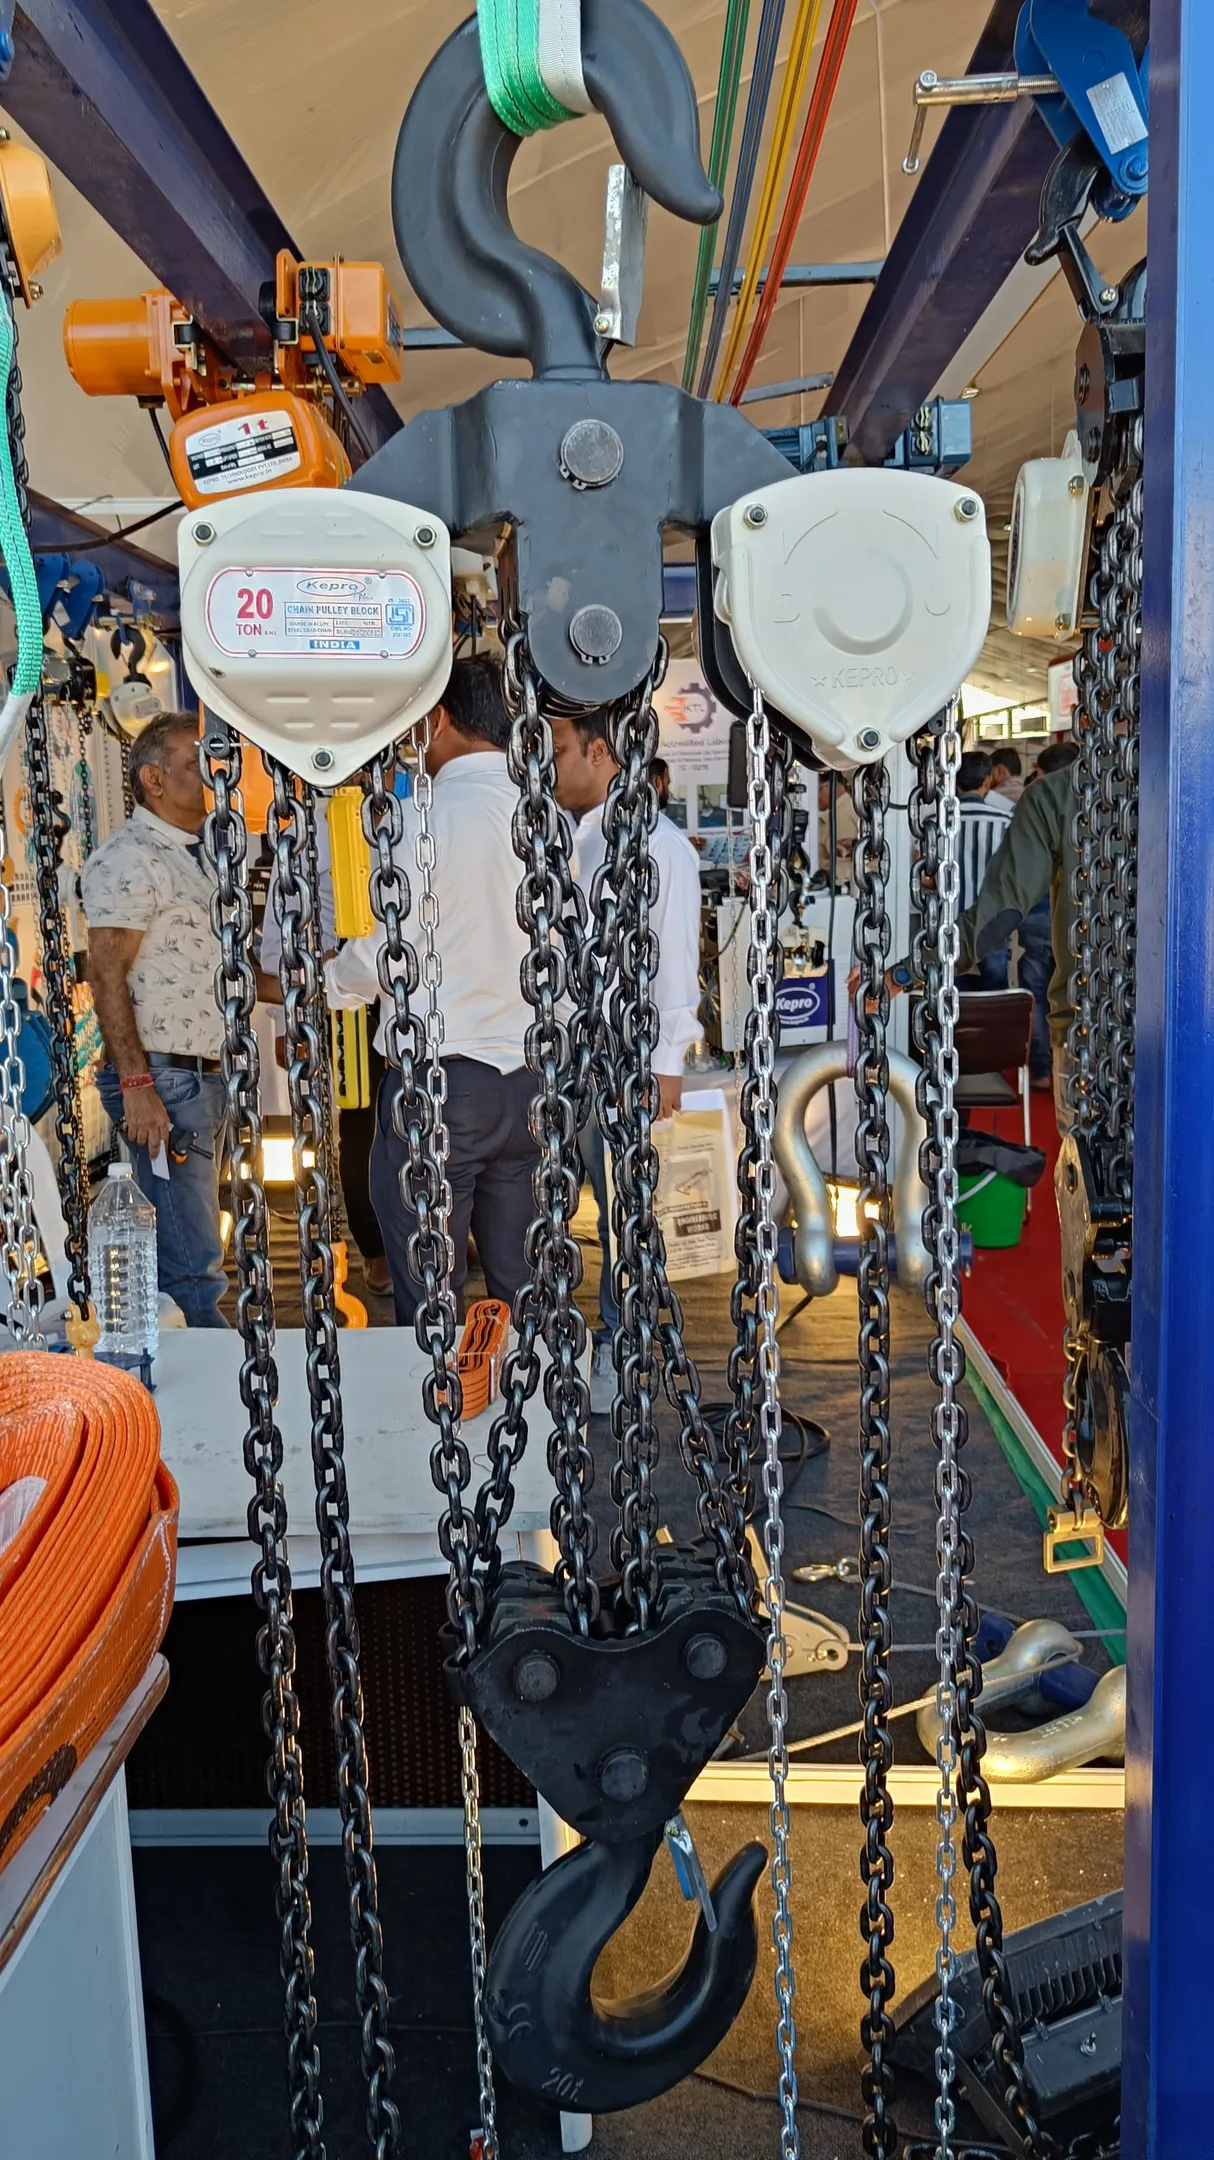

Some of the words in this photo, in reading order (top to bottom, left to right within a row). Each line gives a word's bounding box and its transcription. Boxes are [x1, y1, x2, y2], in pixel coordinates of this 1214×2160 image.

[238, 423, 251, 435] 1
[257, 419, 269, 430] t
[306, 581, 358, 591] Kepro
[237, 588, 273, 619] 20
[287, 605, 314, 614] CHAIN
[316, 606, 348, 615] PULLEY
[350, 607, 379, 616] BLOCK
[235, 623, 262, 636] TON
[313, 641, 356, 650] INDIA
[831, 666, 898, 689] KEPRO
[776, 997, 813, 1012] Kepro
